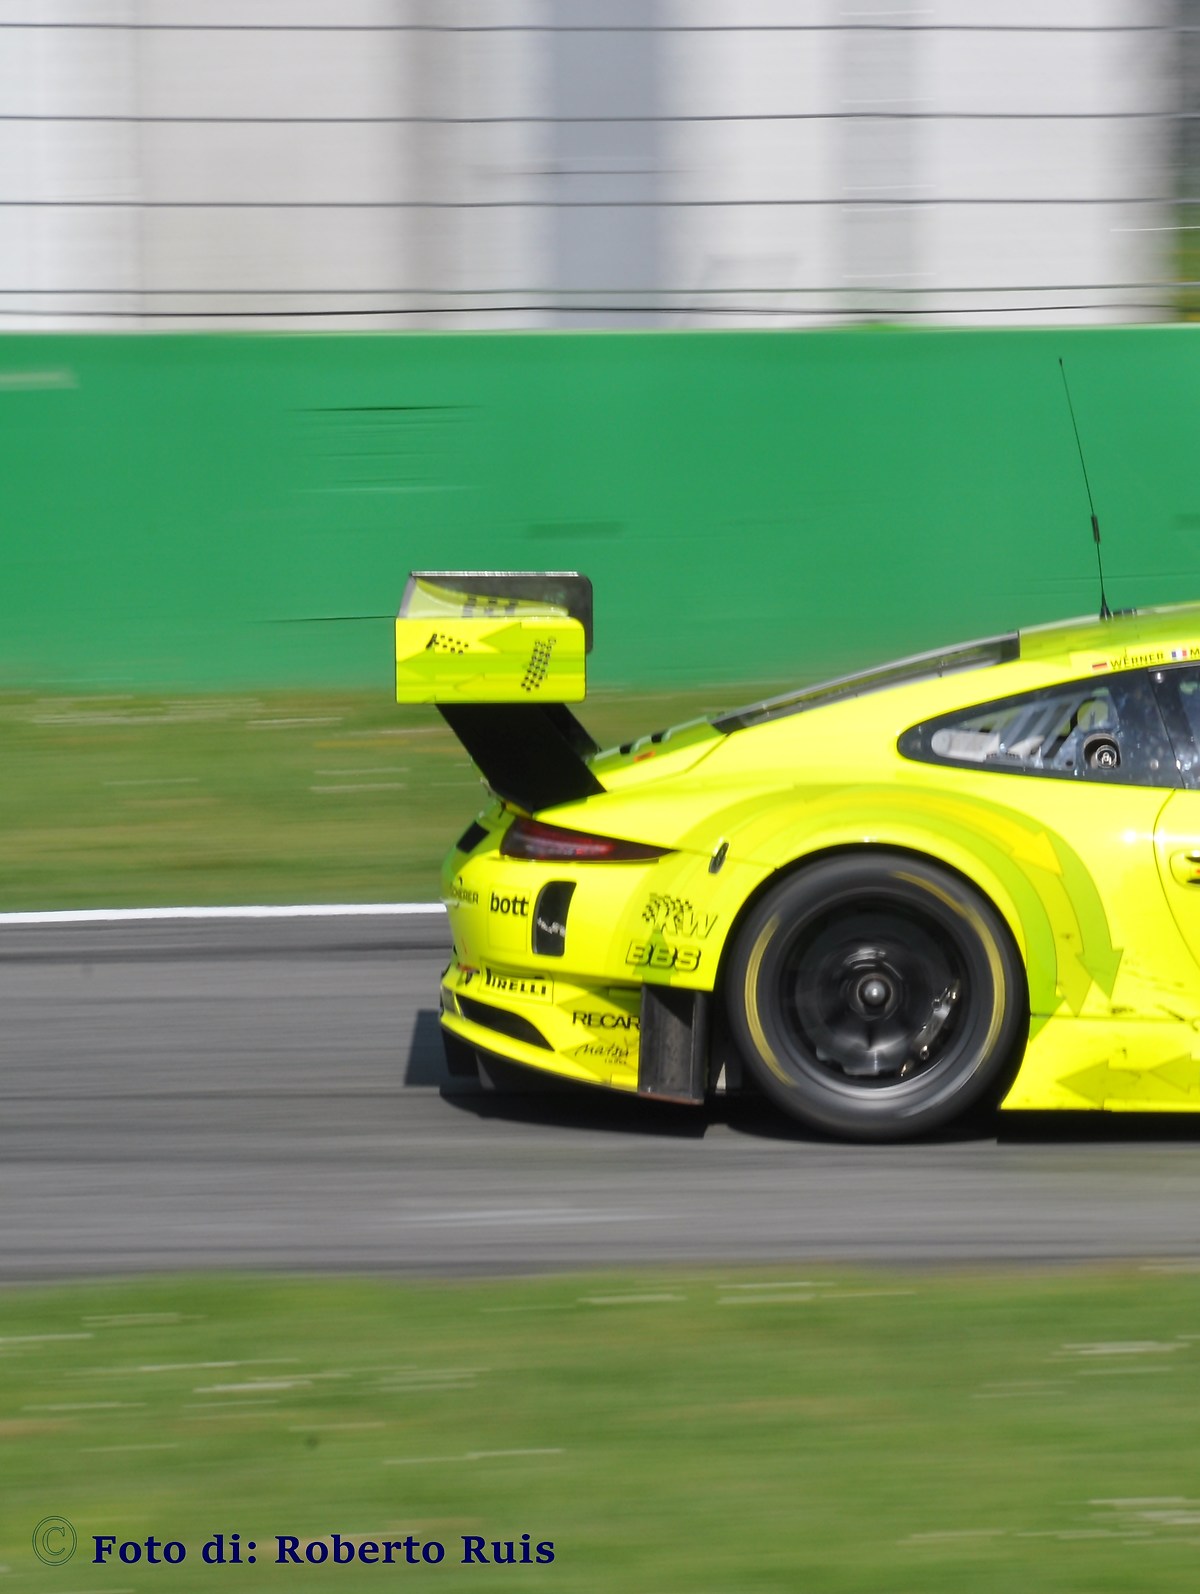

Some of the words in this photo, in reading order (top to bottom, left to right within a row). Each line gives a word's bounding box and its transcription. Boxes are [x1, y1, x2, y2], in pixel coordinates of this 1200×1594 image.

[490, 892, 529, 917] bott
[625, 941, 702, 972] BBS
[485, 967, 547, 995] PIRELLI
